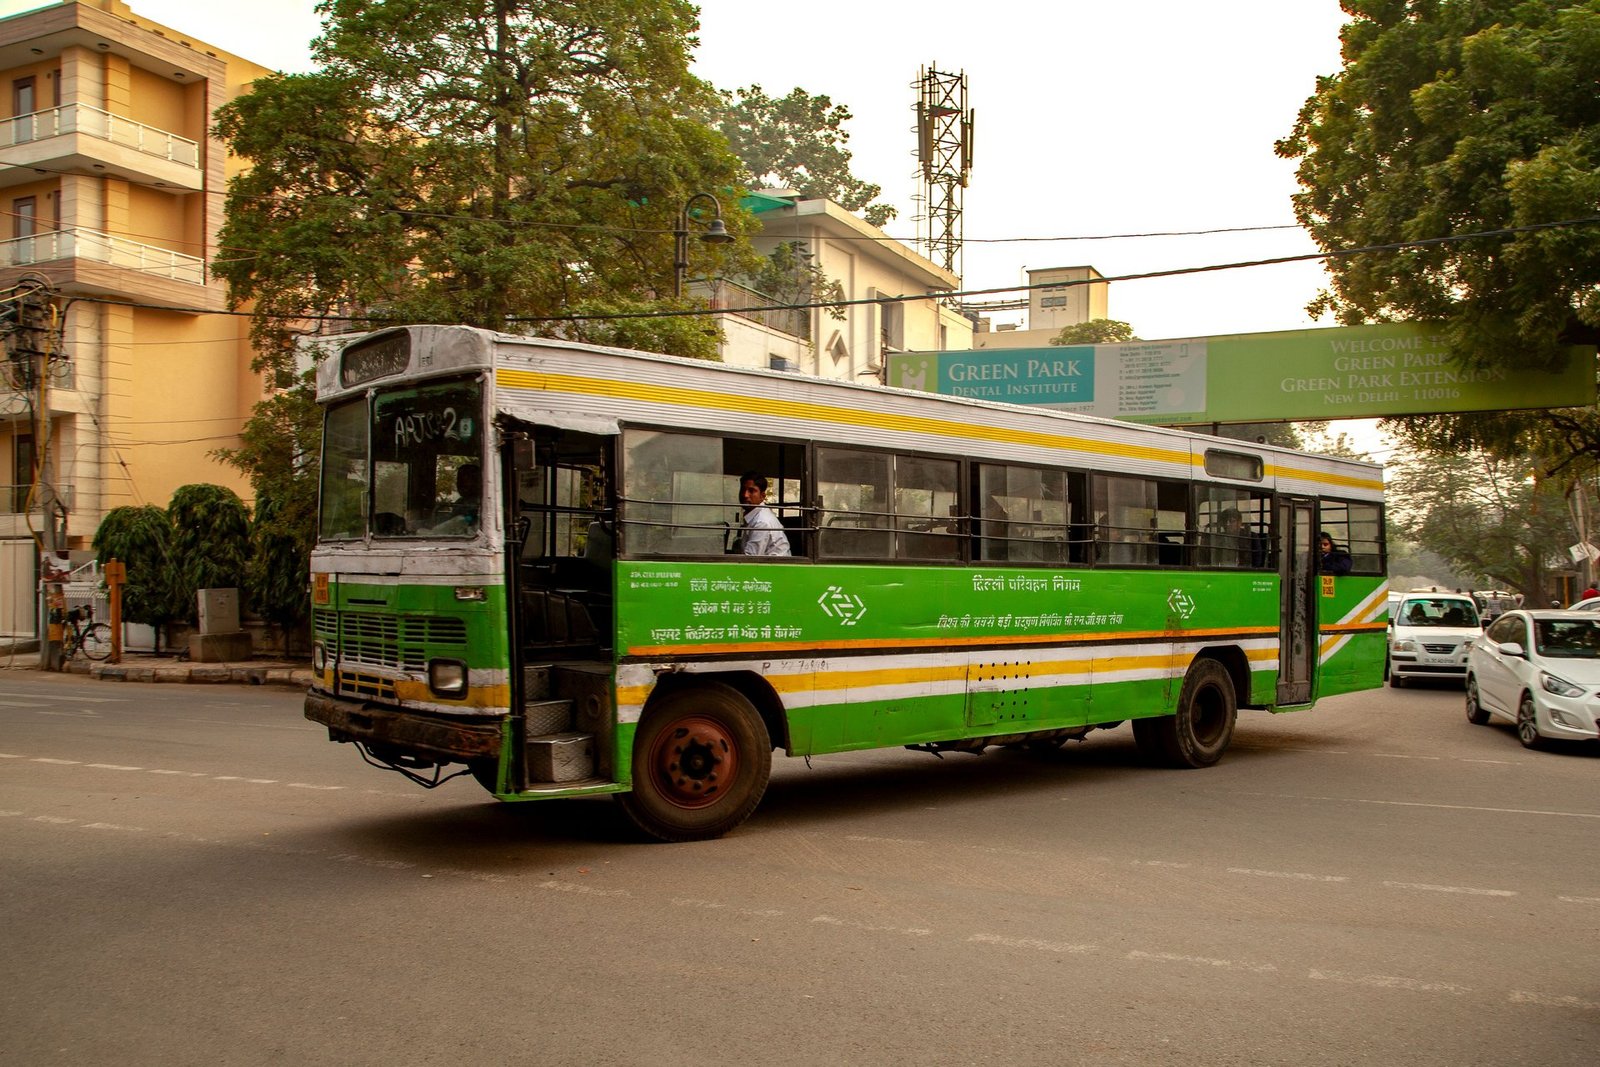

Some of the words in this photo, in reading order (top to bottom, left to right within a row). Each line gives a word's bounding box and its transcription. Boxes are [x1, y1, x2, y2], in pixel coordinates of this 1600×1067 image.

[1331, 338, 1422, 354] WELCOME
[949, 363, 1018, 381] GREEN
[1027, 360, 1082, 378] PARK
[1334, 355, 1396, 372] GREEN
[952, 385, 1001, 397] DENTAL
[1008, 383, 1077, 395] INSTITUTE
[1280, 376, 1341, 393] GREEN
[1347, 373, 1393, 389] PARK
[1324, 393, 1355, 405] NEW
[1358, 390, 1400, 403] DELHI
[1414, 387, 1460, 401] 110016
[972, 574, 1005, 592] दिल्ली
[1008, 575, 1048, 593] परिवहन
[1052, 575, 1082, 592] निगम
